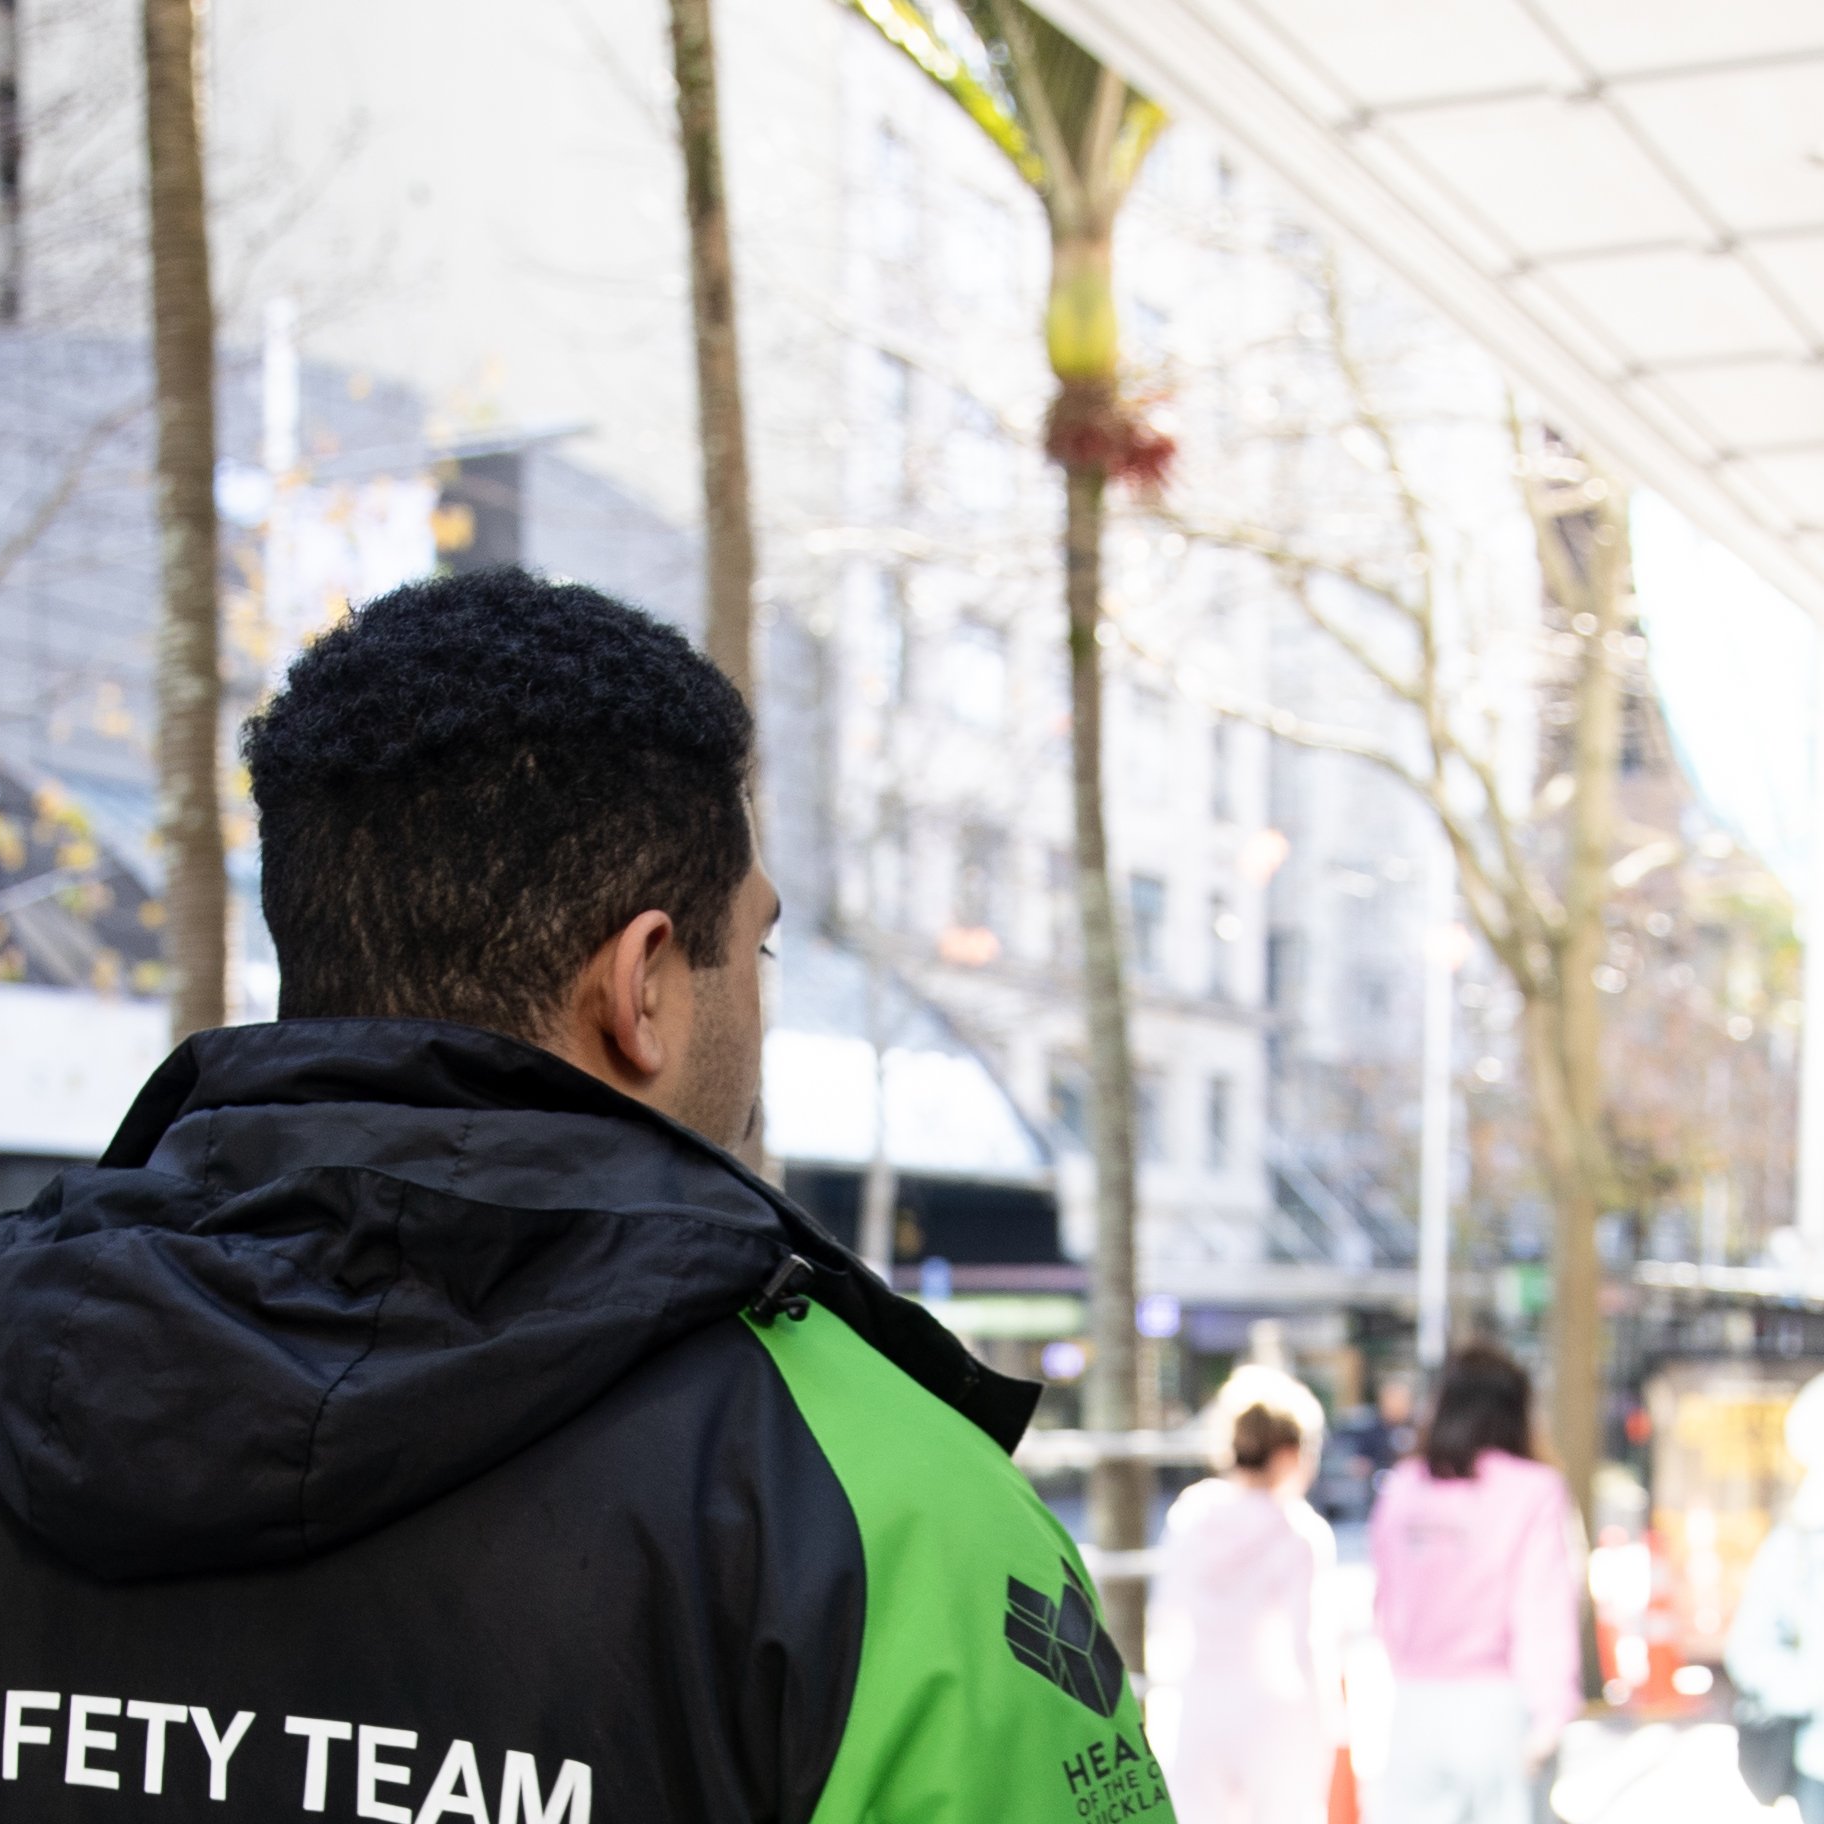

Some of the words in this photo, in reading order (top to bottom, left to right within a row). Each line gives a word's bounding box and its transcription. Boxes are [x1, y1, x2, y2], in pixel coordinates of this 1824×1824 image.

[1062, 1721, 1153, 1795] HEA
[1077, 1791, 1098, 1817] OF
[1103, 1769, 1139, 1799] THE
